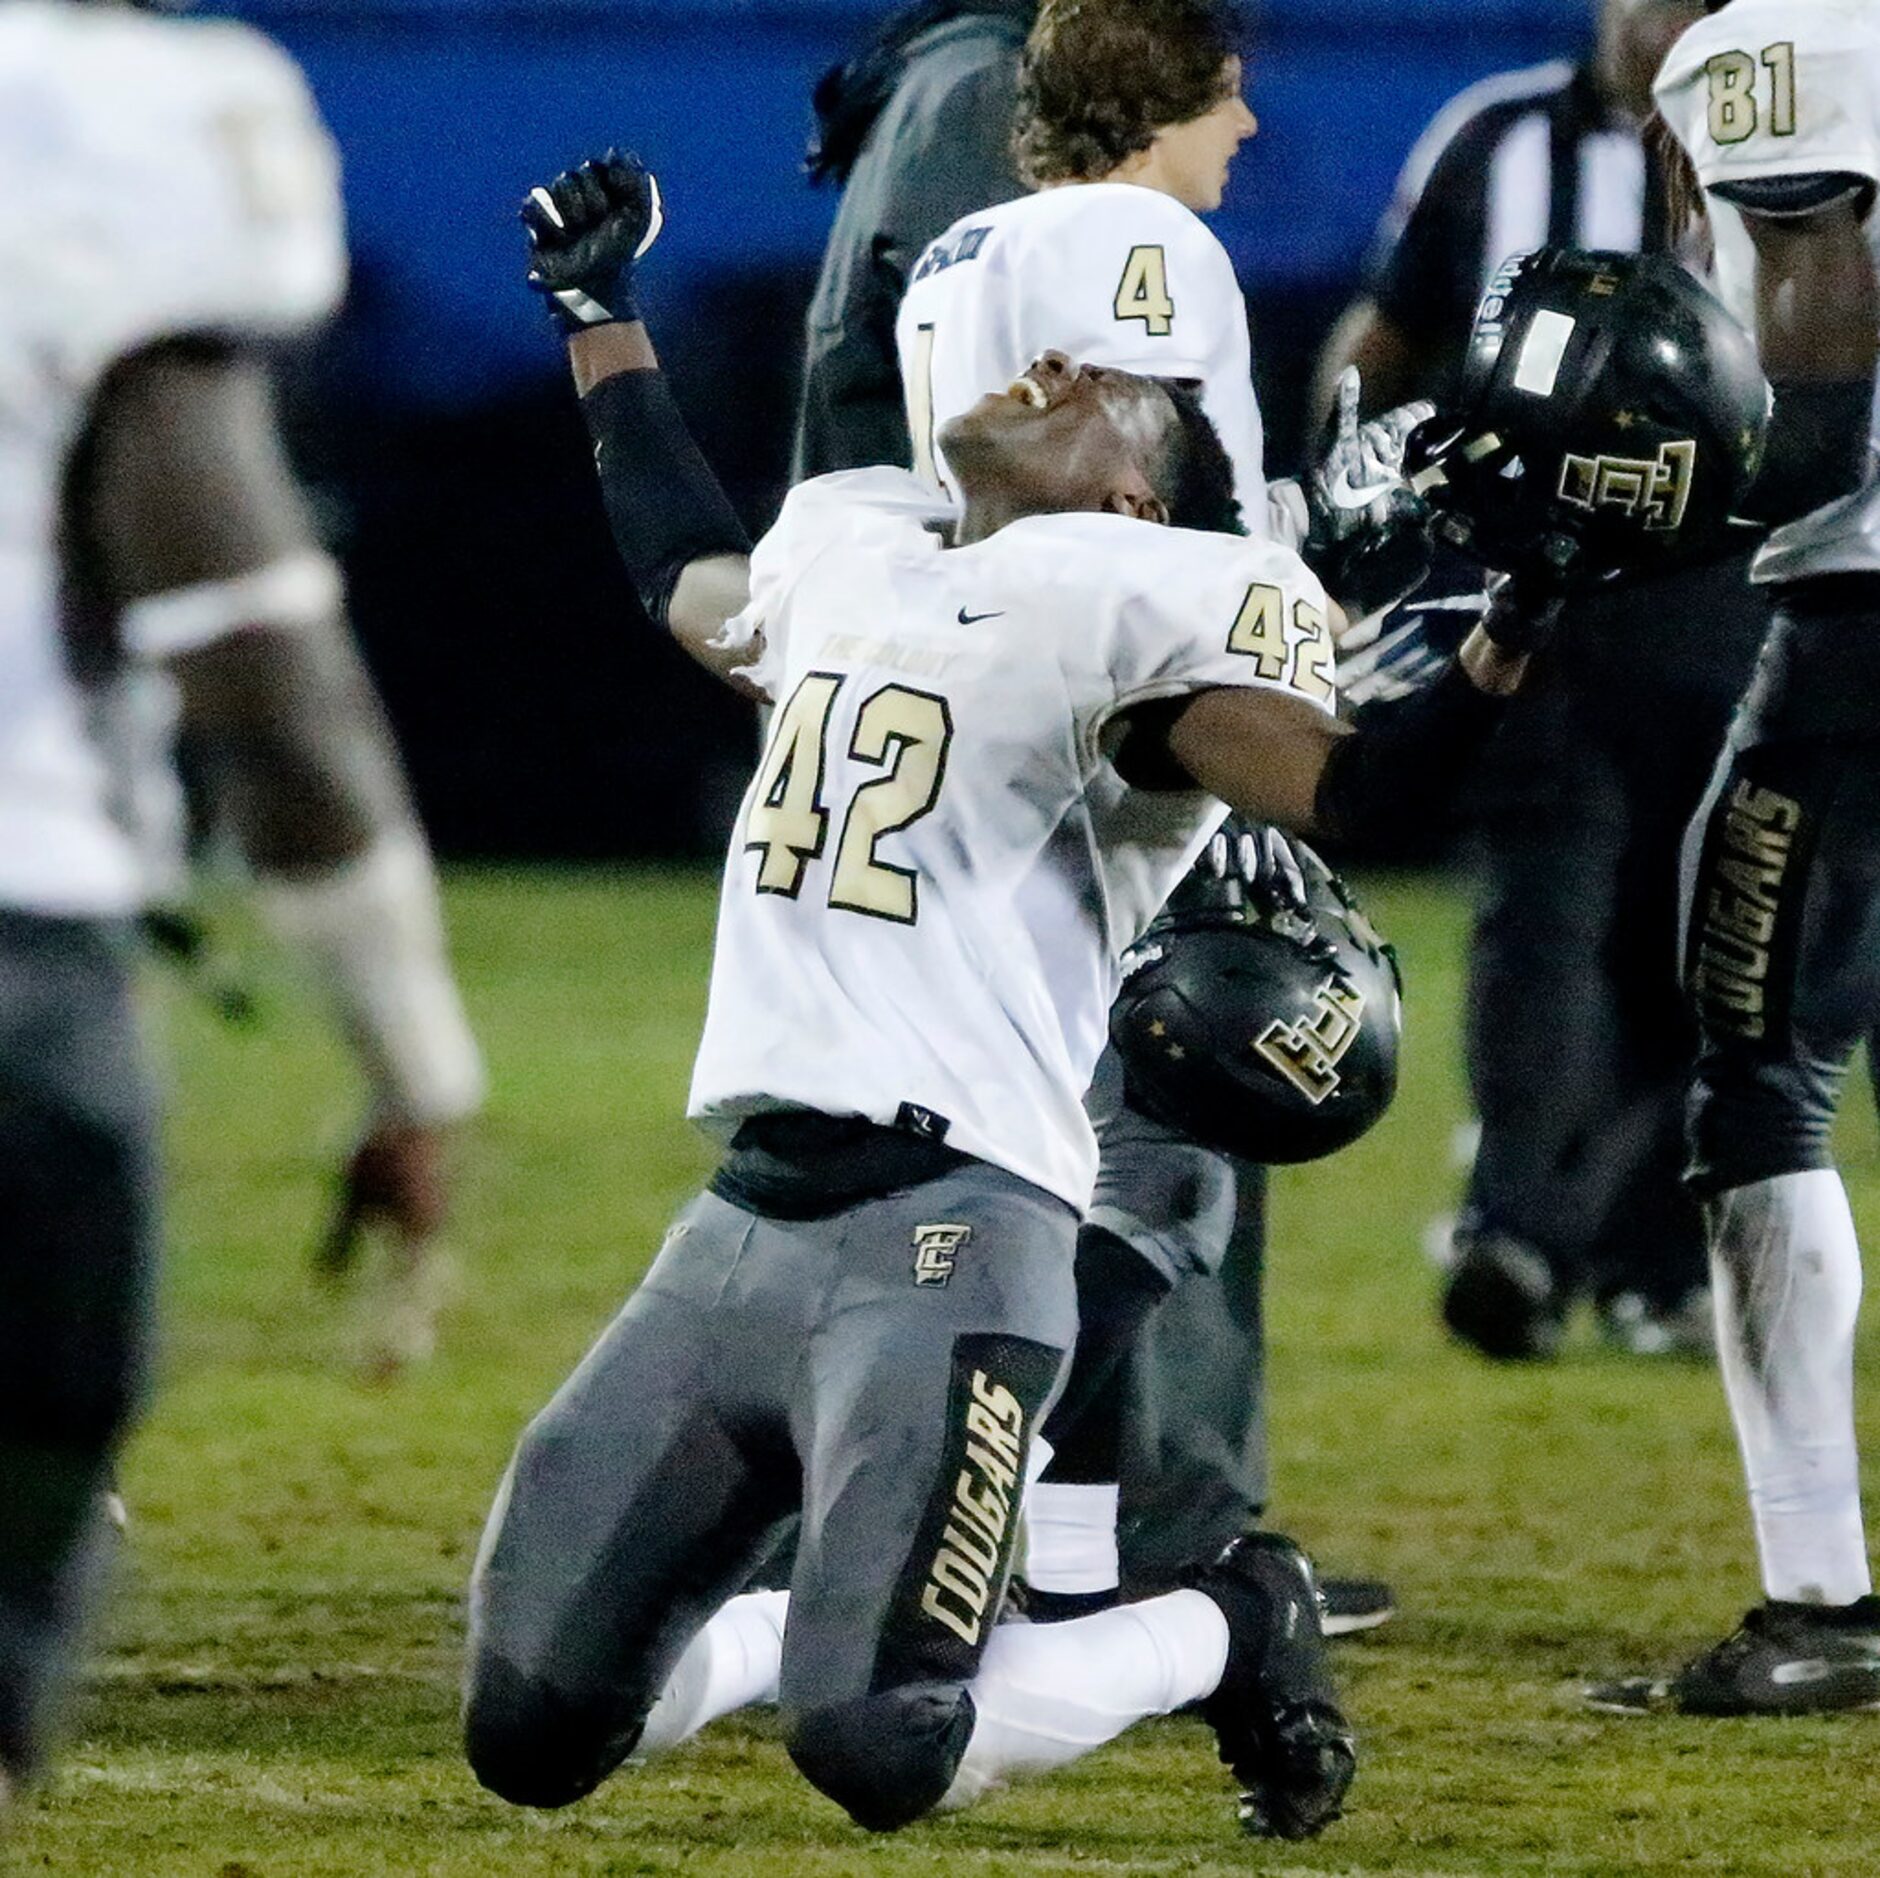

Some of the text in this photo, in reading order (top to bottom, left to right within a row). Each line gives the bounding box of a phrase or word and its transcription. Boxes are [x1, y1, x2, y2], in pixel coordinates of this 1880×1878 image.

[1704, 41, 1796, 146] 81
[1113, 244, 1174, 337] 4
[1225, 582, 1334, 702] 42
[743, 669, 954, 927] 42
[921, 1368, 1025, 1647] COUGARS
